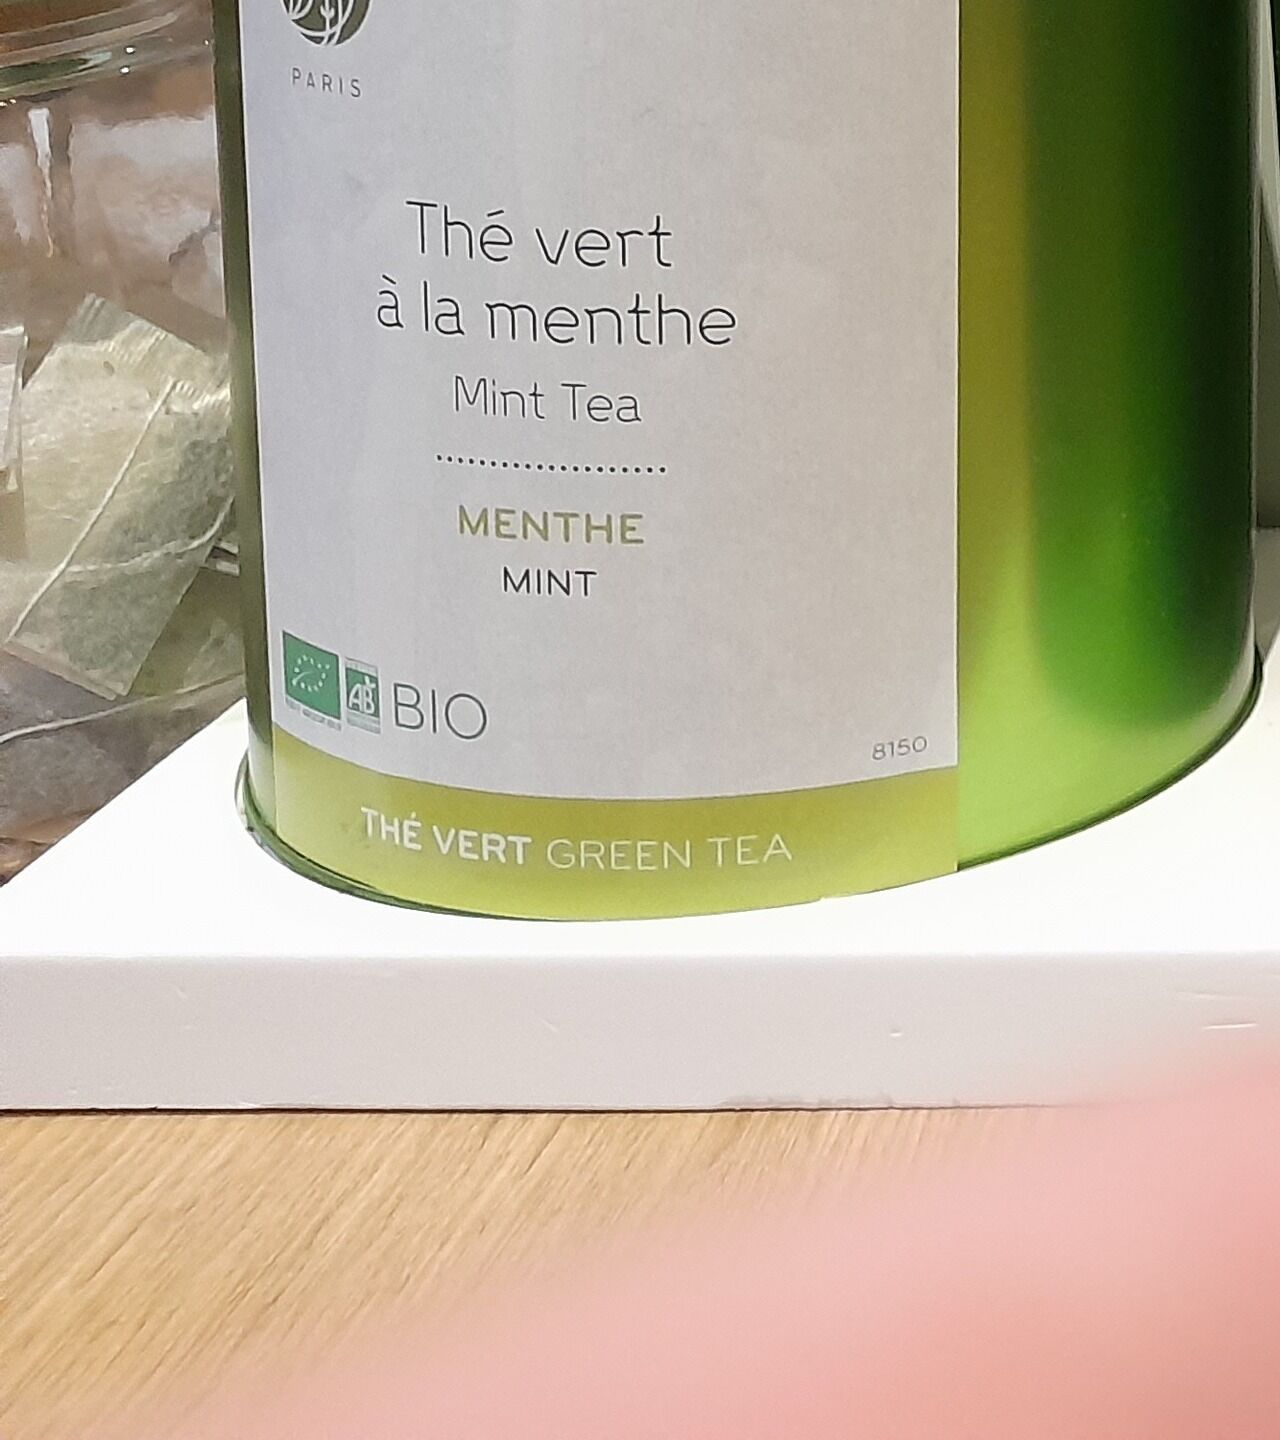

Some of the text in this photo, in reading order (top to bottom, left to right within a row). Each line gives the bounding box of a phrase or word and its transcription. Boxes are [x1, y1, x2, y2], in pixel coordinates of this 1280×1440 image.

[291, 66, 363, 100] PARIS
[405, 200, 672, 268] Thé vert
[377, 274, 738, 346] à la menthe
[452, 375, 642, 423] Mint Tea
[458, 504, 645, 545] MENTHE
[501, 566, 597, 597] MINT
[393, 682, 487, 740] BIO
[871, 735, 927, 761] 8150
[360, 806, 792, 871] THÉ VERT GREEN TEA
